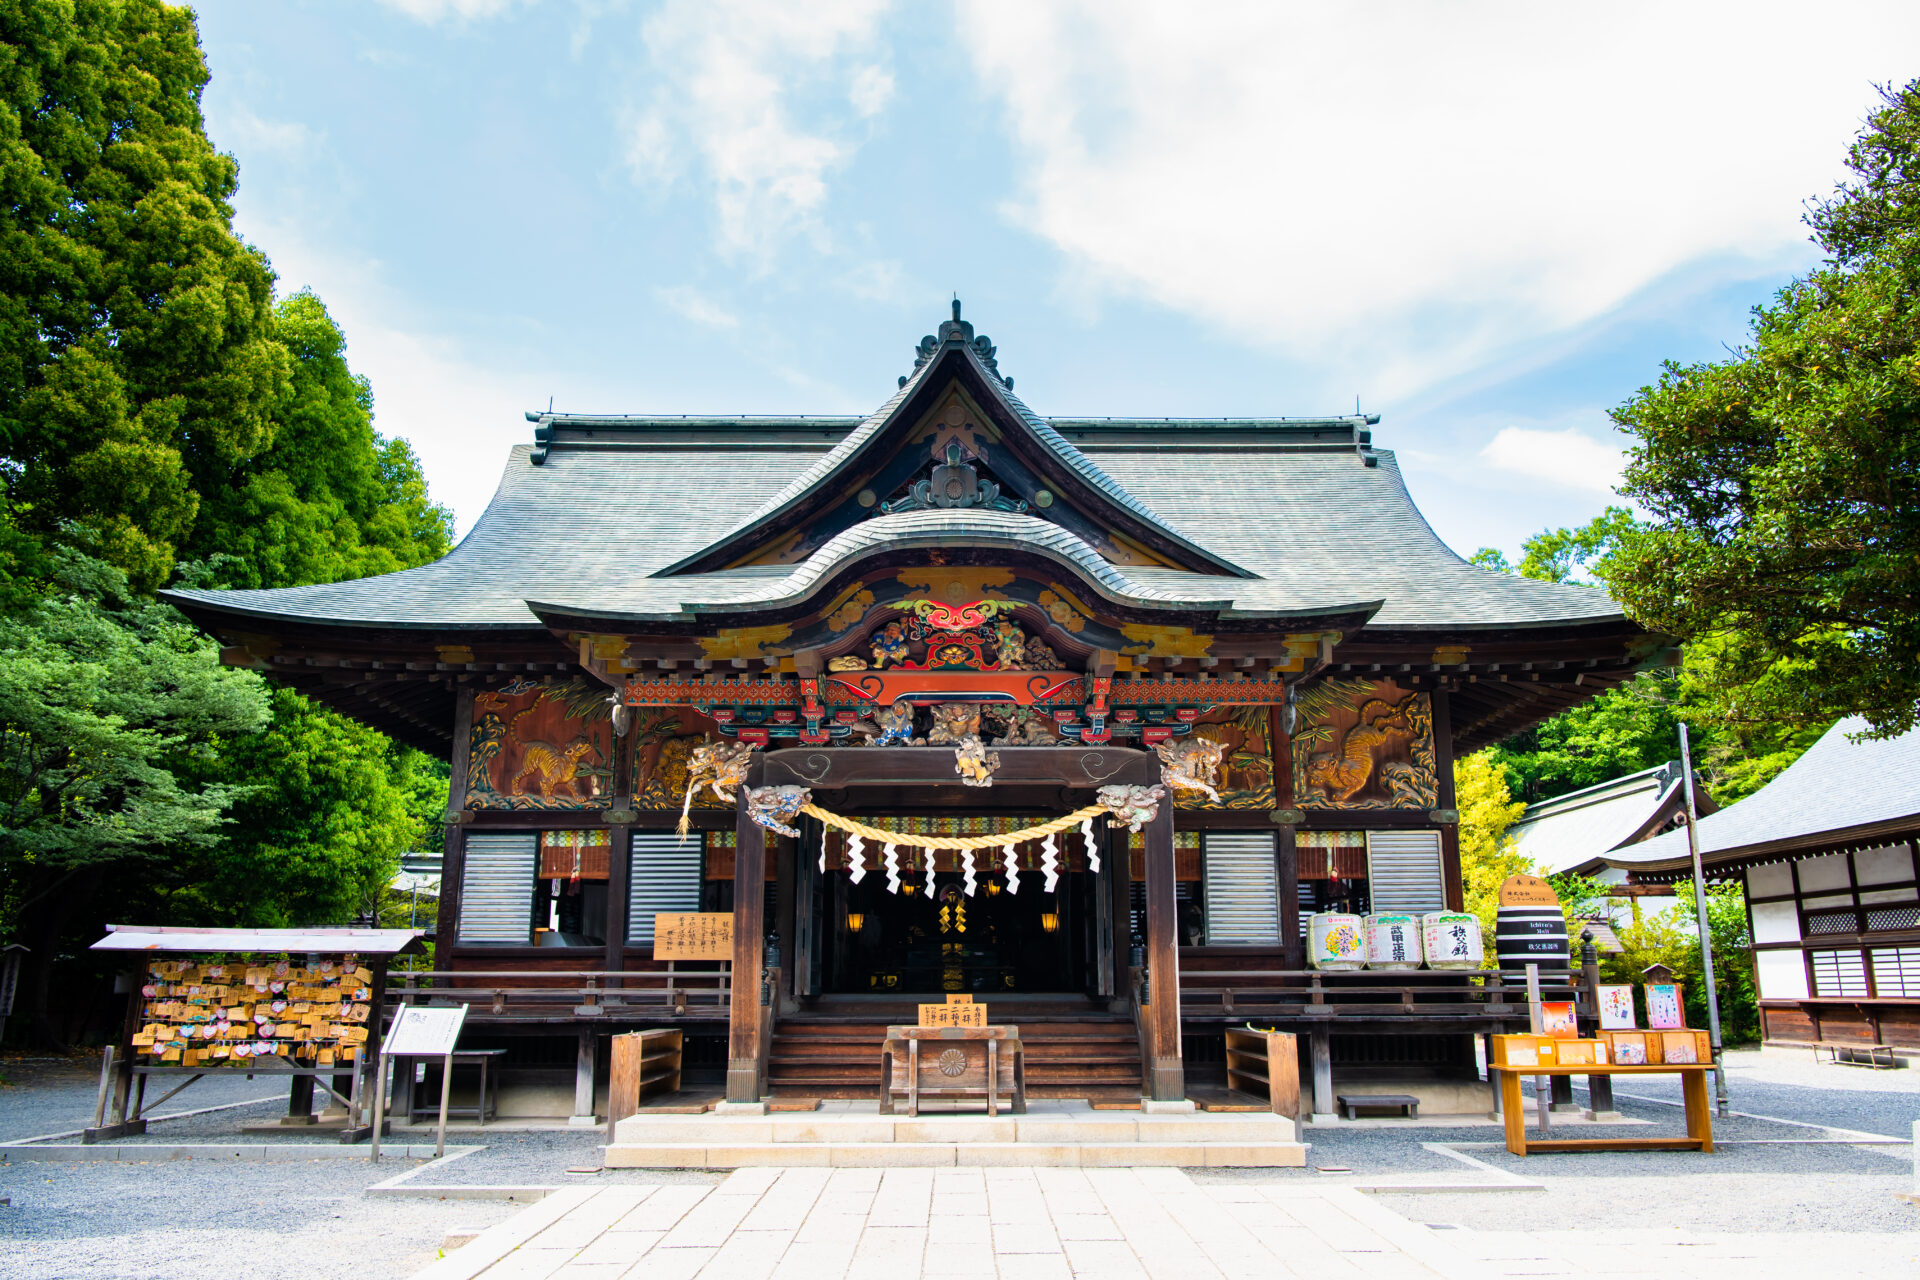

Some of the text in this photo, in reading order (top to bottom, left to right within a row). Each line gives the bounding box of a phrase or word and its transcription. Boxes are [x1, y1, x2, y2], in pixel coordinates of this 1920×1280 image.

[1391, 923, 1405, 961] 武甲正宗
[1448, 924, 1469, 961] 秩父錦
